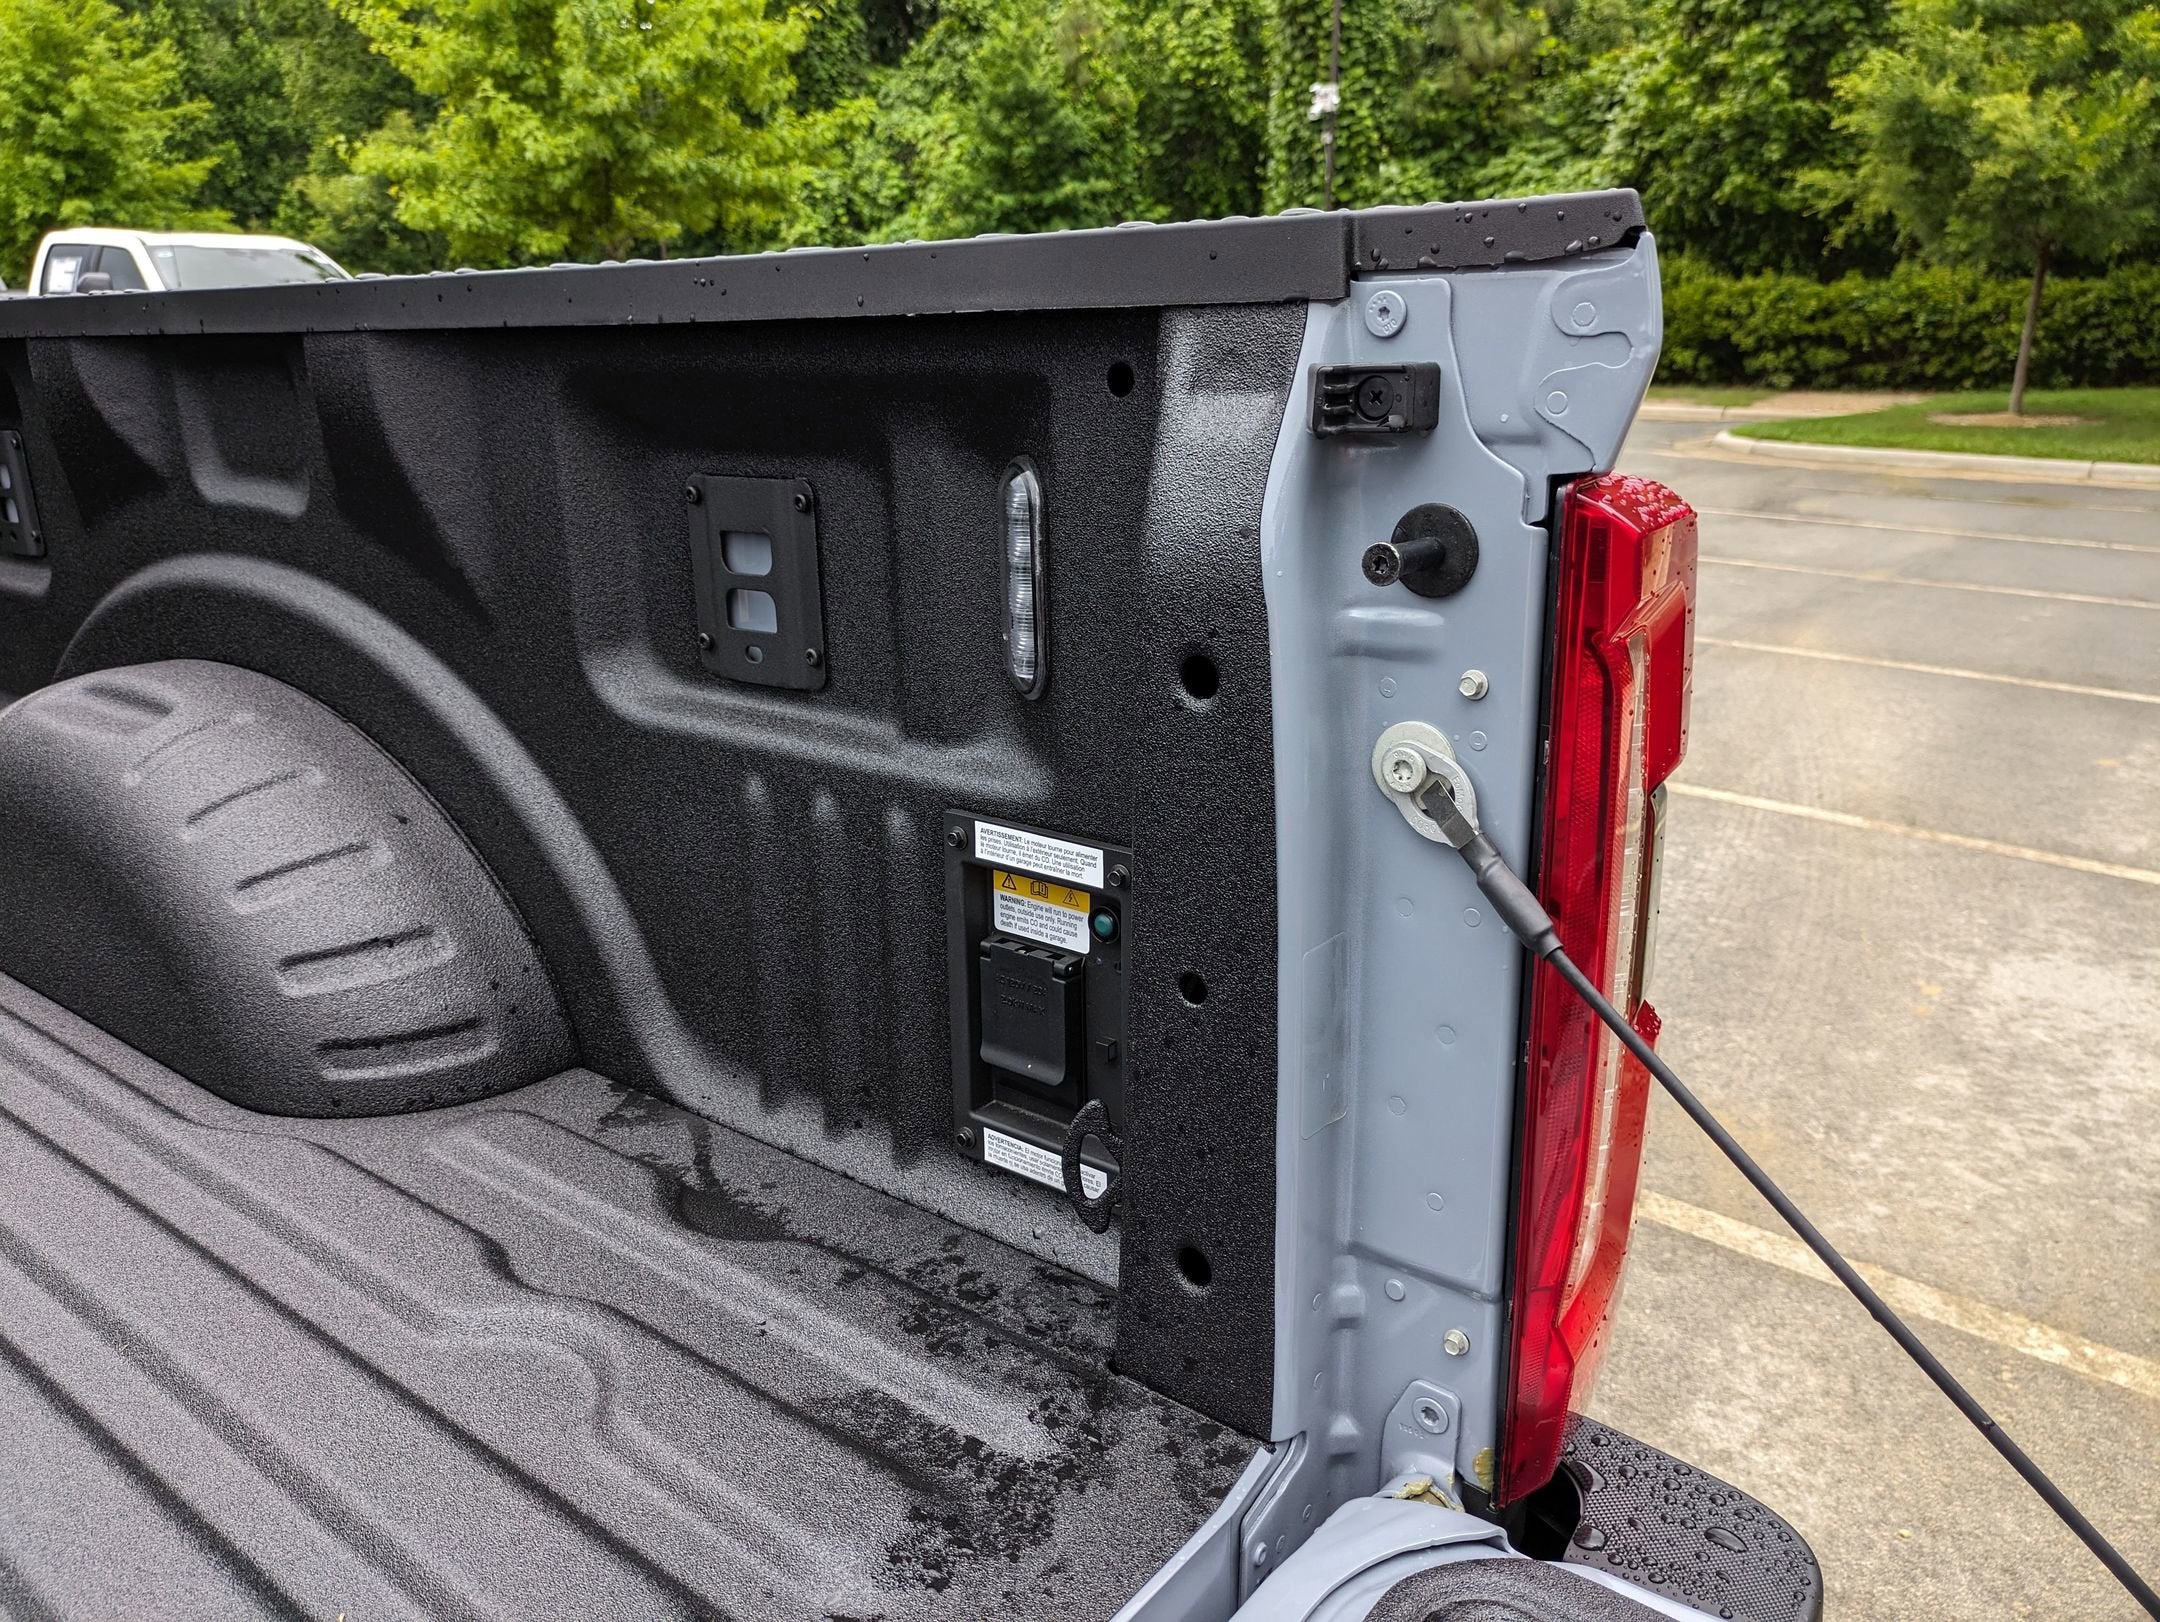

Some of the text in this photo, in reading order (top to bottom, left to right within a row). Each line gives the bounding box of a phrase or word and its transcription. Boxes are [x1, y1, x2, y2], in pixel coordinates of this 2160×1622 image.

[981, 828, 1023, 843] AVERTISSEMENT:
[1032, 841, 1047, 849] moteur
[1076, 851, 1097, 861] alimenter
[1004, 841, 1025, 851] Utilisation
[1080, 860, 1096, 869] Quand
[986, 843, 1001, 852] moteur
[1063, 862, 1085, 873] utilisation
[1017, 858, 1032, 867] garage
[1033, 862, 1043, 870] peut
[1000, 894, 1026, 907] WARNING:
[1028, 902, 1044, 913] Engine
[1069, 914, 1083, 923] power
[1018, 908, 1034, 918] outside
[1058, 918, 1077, 931] Running
[1000, 912, 1077, 938] engine emits CO and could cause
[1001, 919, 1013, 928] death
[1019, 924, 1029, 933] used
[1031, 928, 1044, 937] inside
[1031, 1151, 1043, 1160] motor
